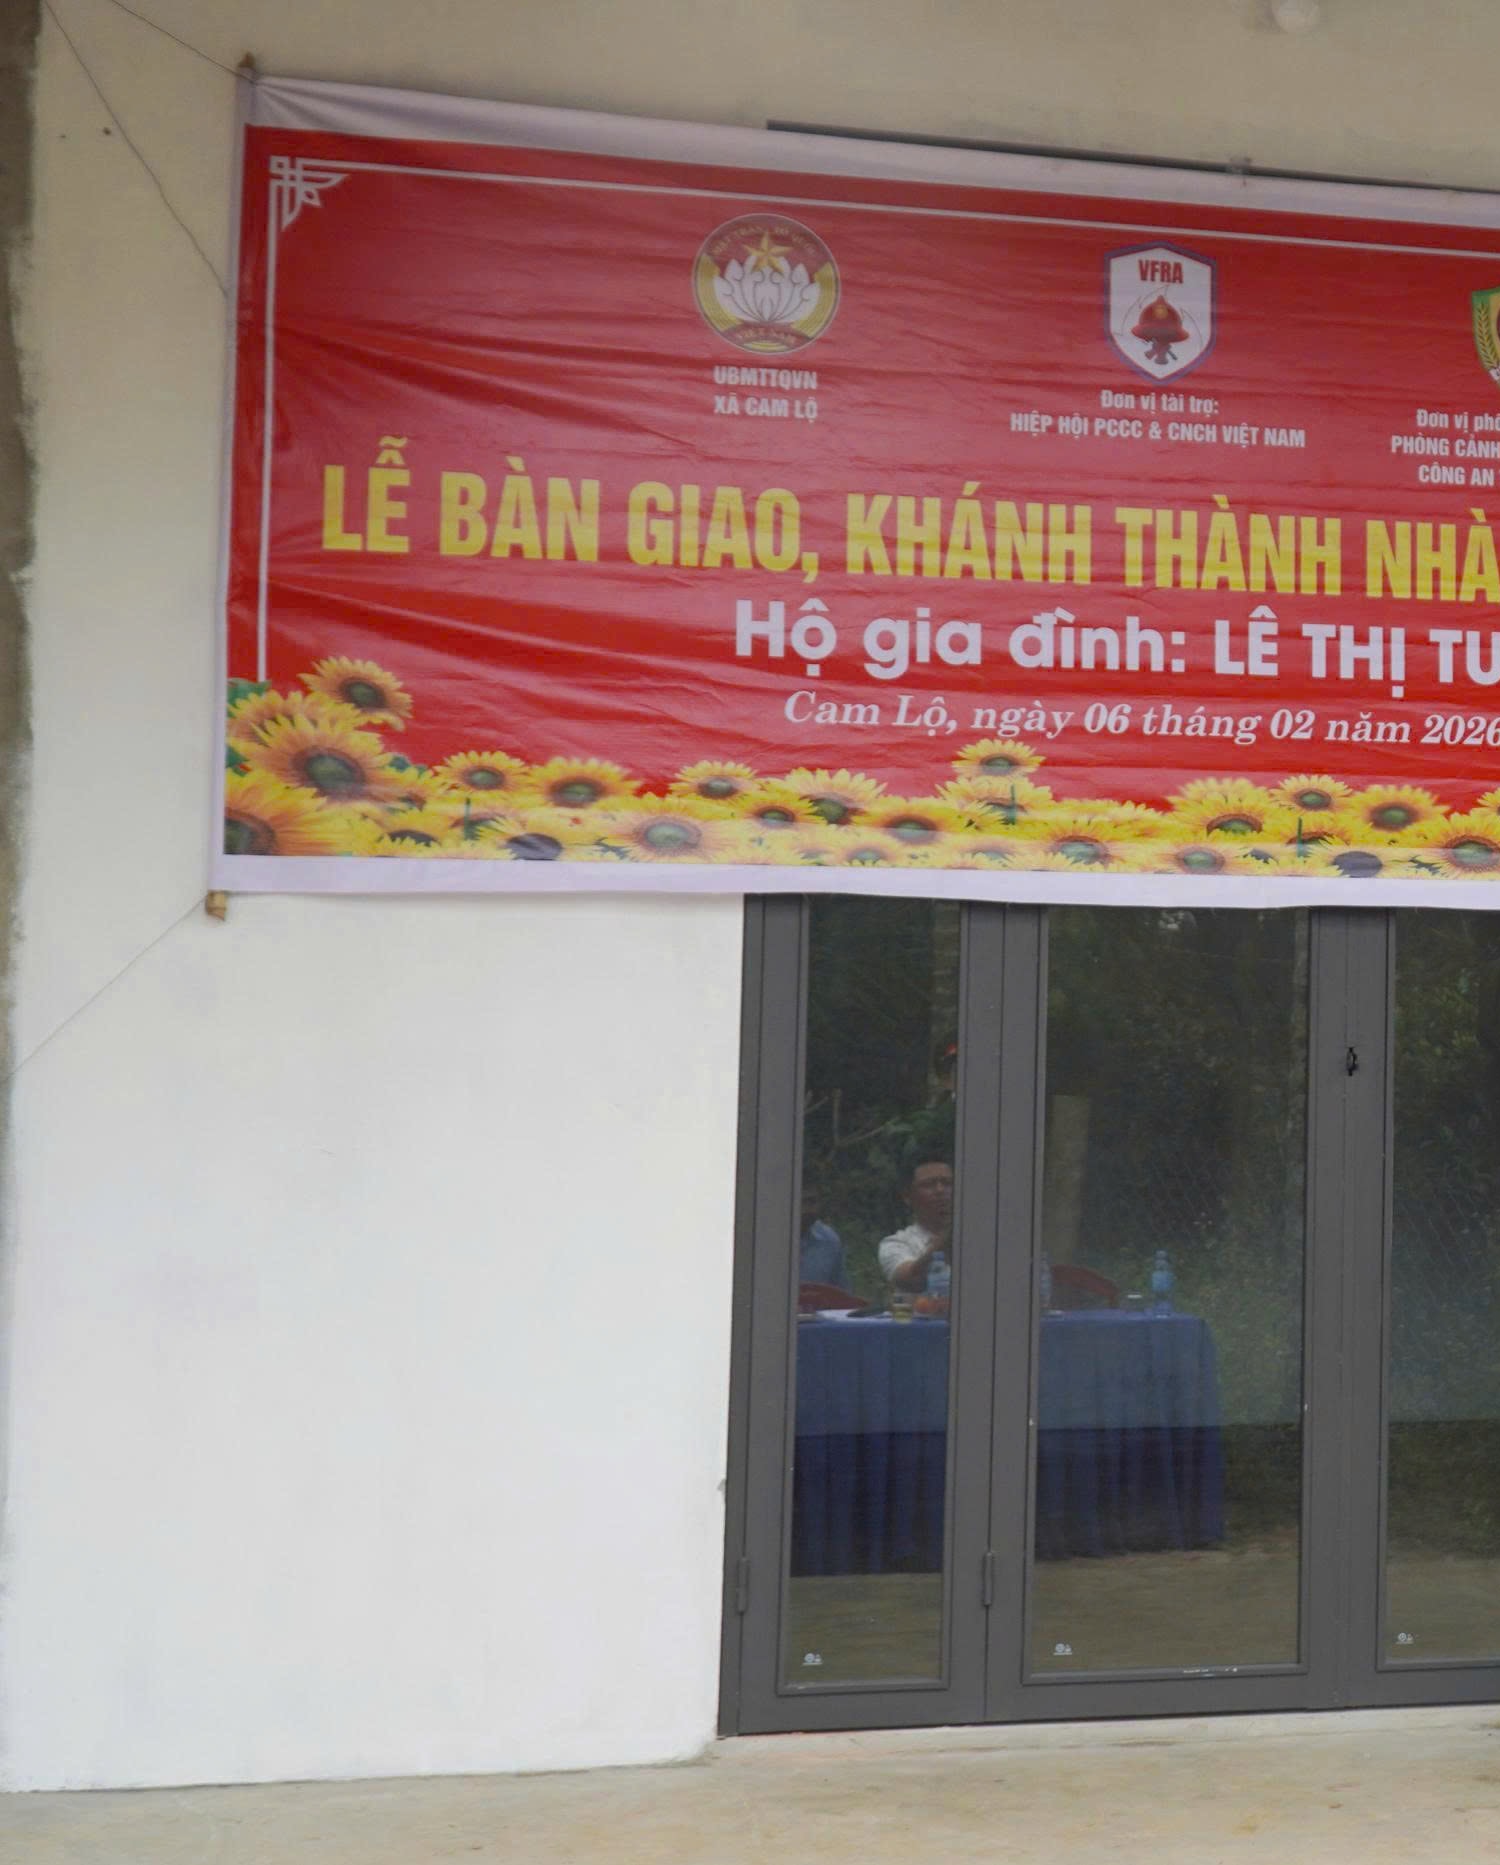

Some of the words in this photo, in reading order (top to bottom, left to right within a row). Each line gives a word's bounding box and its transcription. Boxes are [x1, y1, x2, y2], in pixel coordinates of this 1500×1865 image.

[1138, 259, 1184, 284] VFRA
[713, 365, 818, 390] UBMTTQVN
[713, 392, 739, 415] XÃ
[744, 397, 788, 418] CAM
[794, 396, 818, 423] LỘ
[1101, 389, 1135, 409] Đơn
[1140, 392, 1156, 414] vị
[1162, 391, 1184, 412] tài
[1189, 394, 1219, 417] trợ:
[1010, 411, 1053, 437] HIỆP
[1058, 412, 1088, 439] HỘI
[1094, 417, 1143, 438] PCCC
[1149, 421, 1161, 440] &
[1168, 422, 1217, 443] CNCH
[1222, 423, 1259, 448] VIỆT
[1264, 427, 1306, 447] NAM
[1416, 408, 1449, 428] Đơn
[1455, 411, 1468, 433] vị
[1391, 433, 1449, 456] PHÒNG
[1455, 433, 1500, 459] CẢNH
[1418, 461, 1465, 485] CÔNG
[1470, 468, 1494, 487] AN
[322, 436, 410, 553] LỄ
[439, 456, 600, 562] BÀN
[627, 480, 820, 583] GIAO,
[846, 480, 1092, 585] KHÁNH
[1116, 494, 1341, 597] THÀNH
[735, 598, 837, 677] Hộ
[863, 607, 982, 680] gia
[1008, 606, 1186, 673] đình:
[1214, 605, 1279, 676] LÊ
[1302, 623, 1406, 698] THỊ
[784, 690, 880, 727] Cam
[892, 694, 958, 737] Lộ,
[970, 700, 1074, 739] ngày
[1084, 703, 1132, 734] 06
[1142, 704, 1262, 744] tháng
[1269, 709, 1316, 740] 02
[1324, 711, 1410, 744] năm
